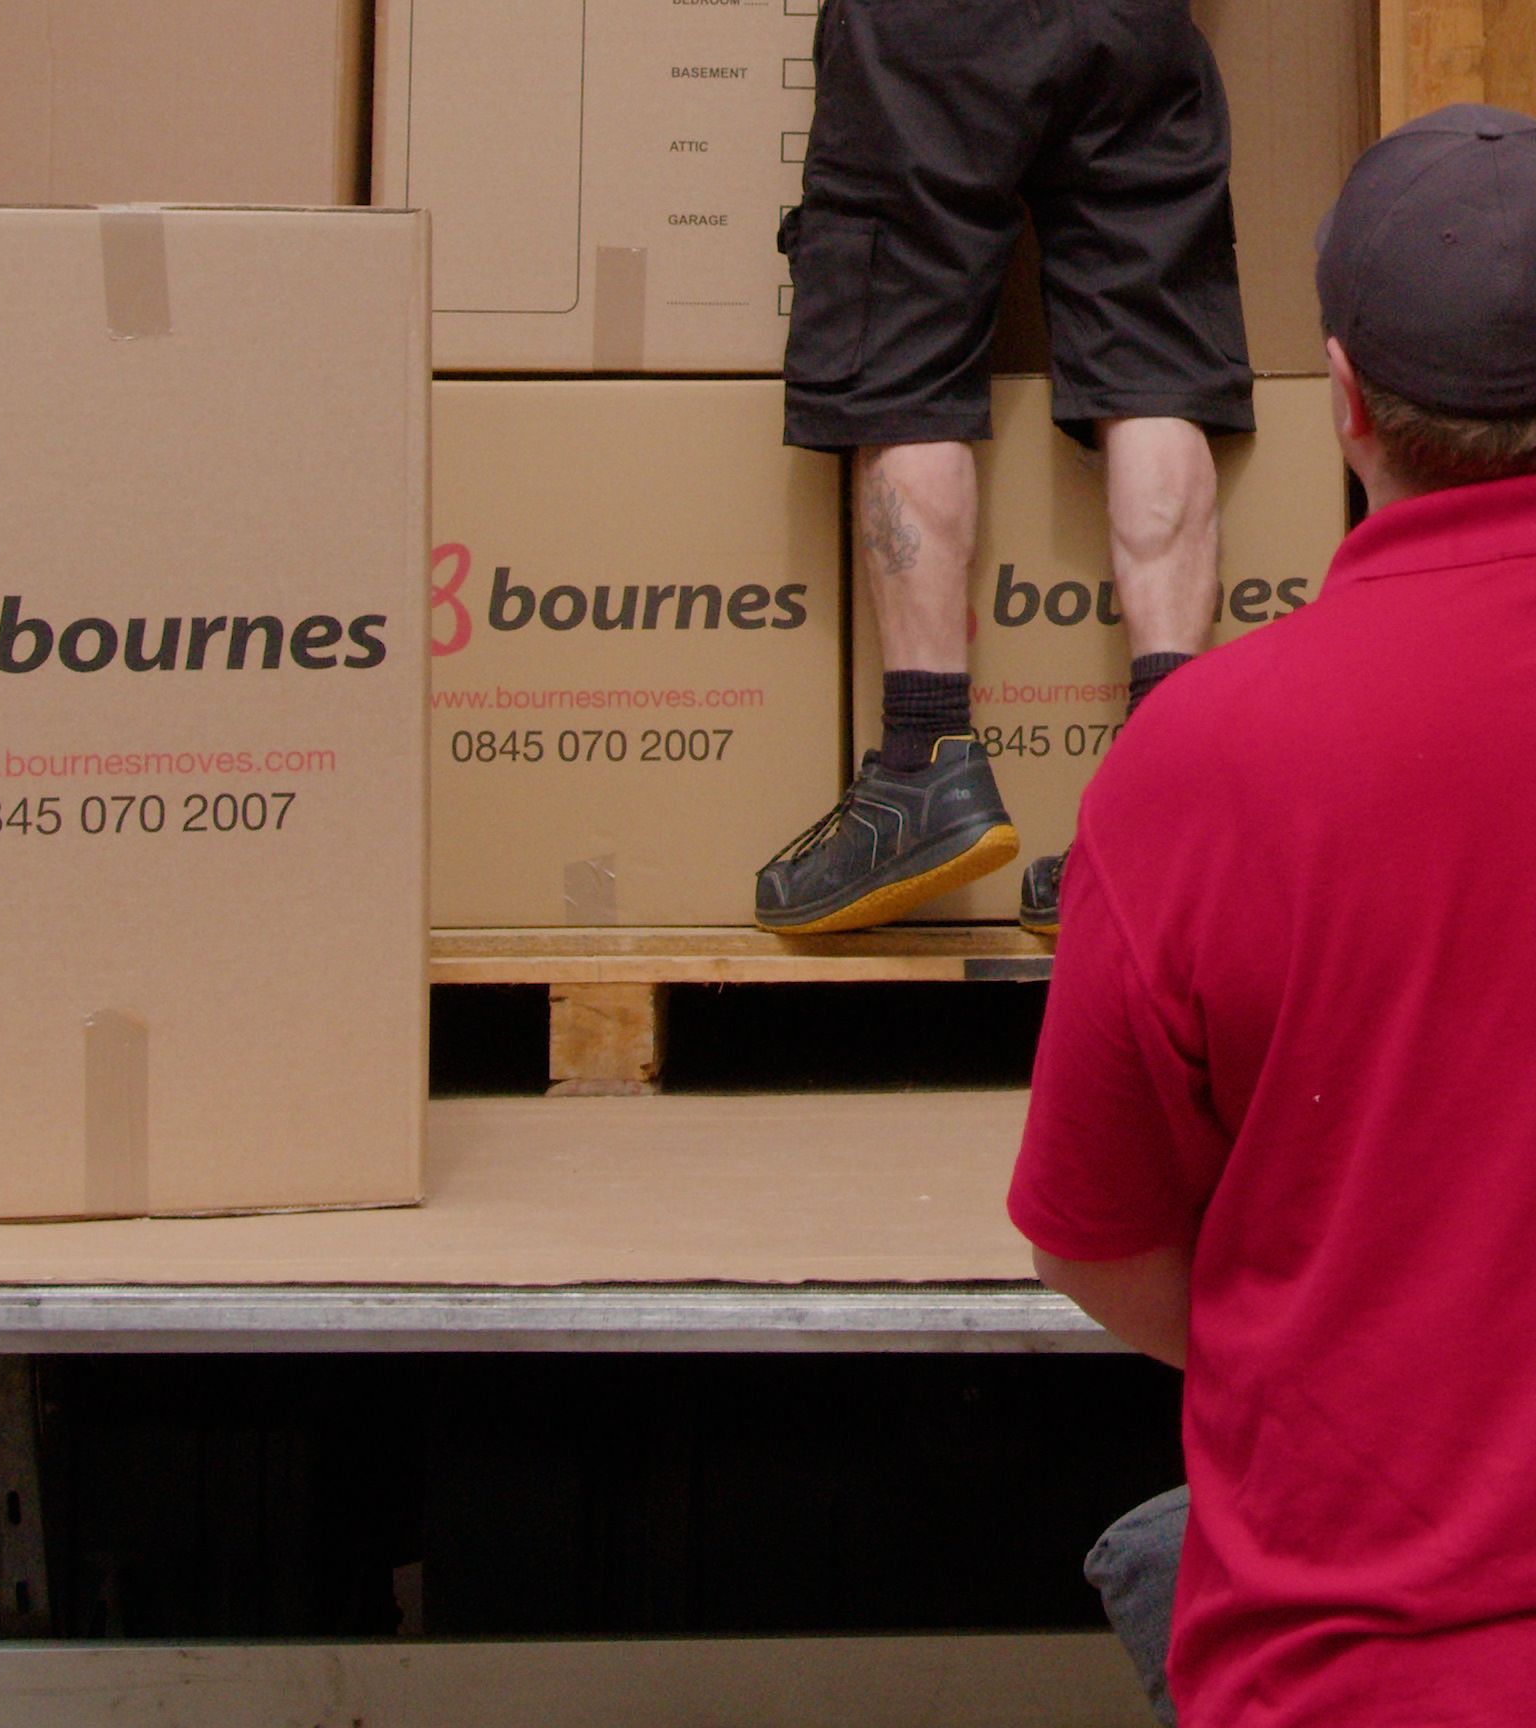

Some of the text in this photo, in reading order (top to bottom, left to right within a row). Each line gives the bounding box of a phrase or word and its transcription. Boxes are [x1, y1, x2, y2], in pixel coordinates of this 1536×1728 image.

[671, 67, 748, 79] BASEMENT
[669, 140, 709, 152] ATTIC
[668, 214, 728, 226] GARAGE
[488, 567, 809, 631] bournes
[452, 729, 734, 762] 0845 070 2007
[973, 724, 1124, 757] 845 07
[80, 795, 166, 834] 070
[182, 792, 297, 832] 2007
